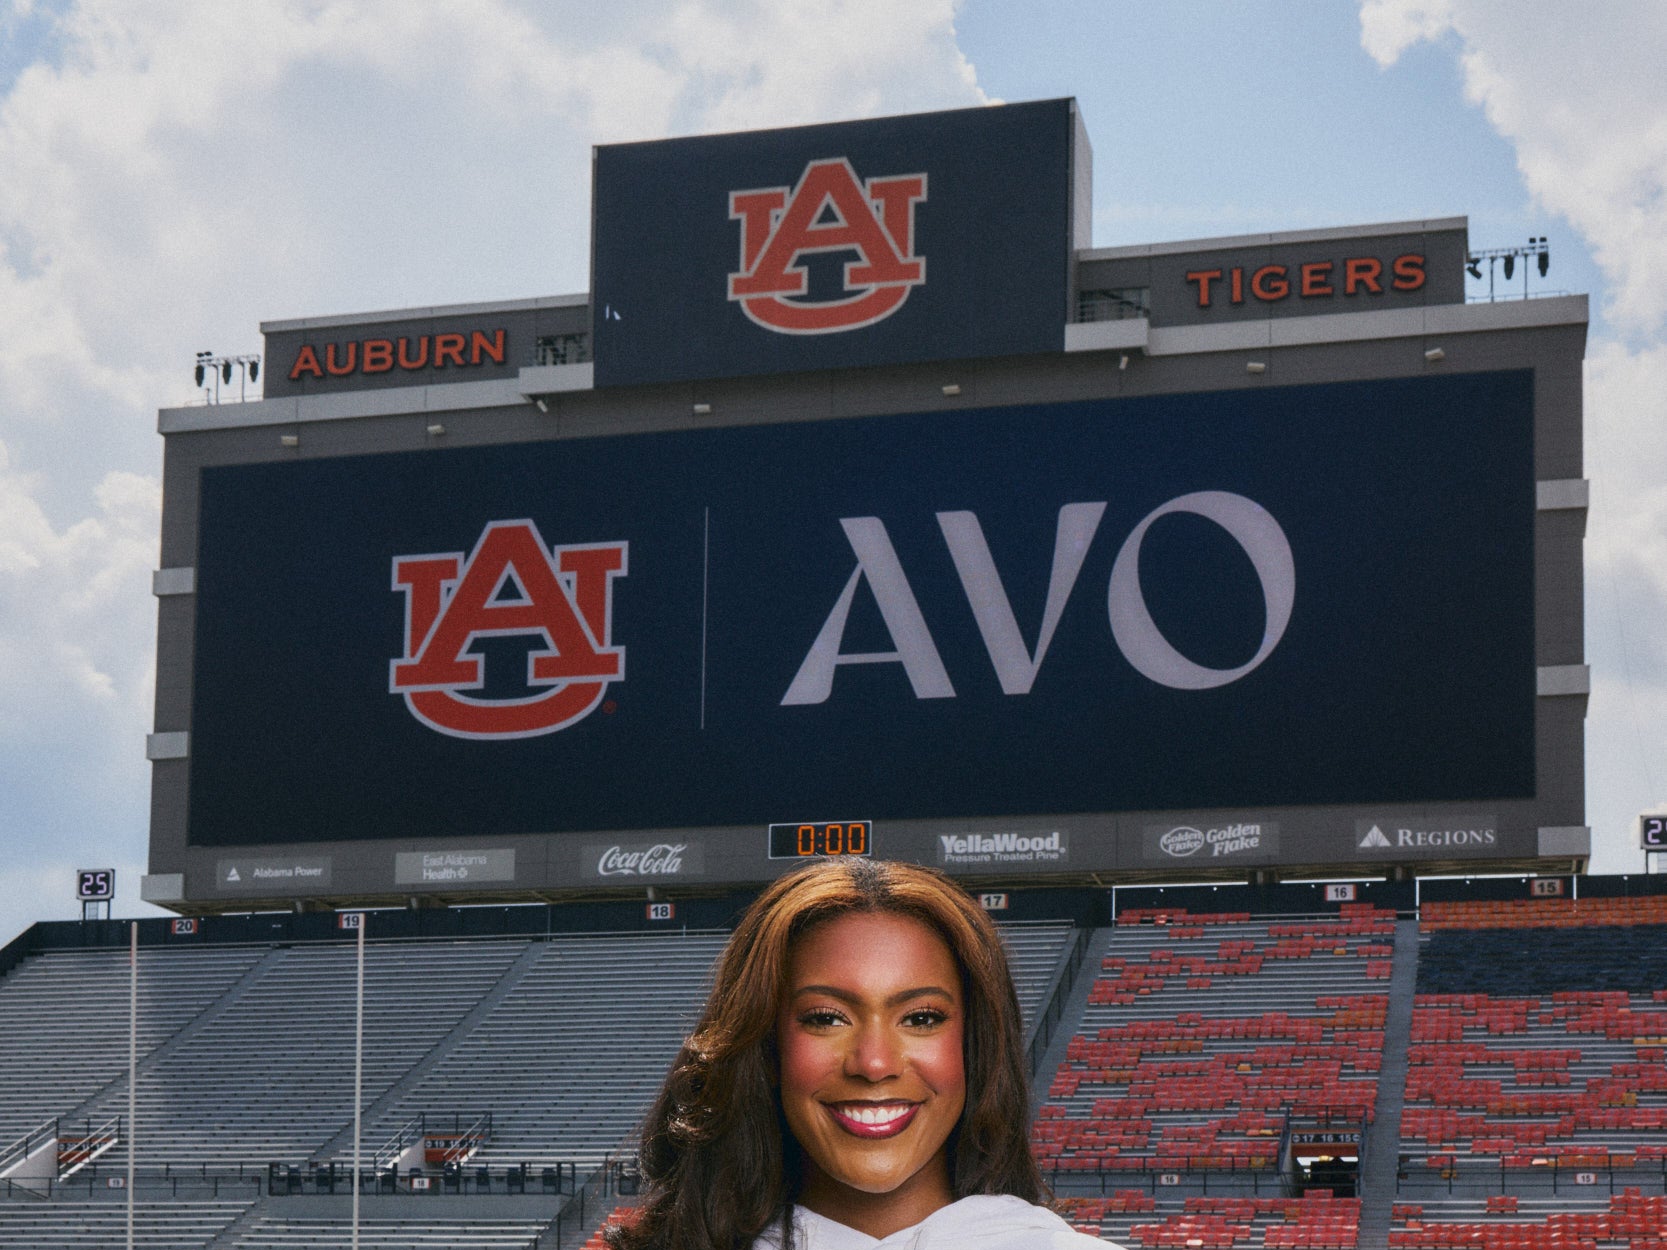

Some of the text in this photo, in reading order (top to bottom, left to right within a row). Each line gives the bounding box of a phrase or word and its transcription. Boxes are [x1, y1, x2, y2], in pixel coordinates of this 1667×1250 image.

[1187, 255, 1426, 305] TIGERS
[289, 329, 506, 379] AUBURN
[780, 490, 1296, 706] AVO
[1206, 824, 1261, 844] Golden
[1648, 820, 1667, 843] 2
[797, 823, 865, 856] 0:00
[1164, 832, 1201, 845] Golden
[1168, 841, 1200, 852] Flake
[1212, 837, 1259, 857] Flake
[598, 844, 688, 876] Coca-Cola
[945, 850, 1059, 863] Pressure Treated Pine
[253, 866, 323, 878] Alabama Power
[423, 868, 457, 880] Health
[82, 873, 107, 895] 25
[1538, 881, 1556, 894] 15
[1334, 887, 1347, 898] 16
[984, 895, 1001, 908] 17
[652, 905, 669, 918] 18
[177, 920, 193, 932] 20
[344, 915, 359, 928] 19
